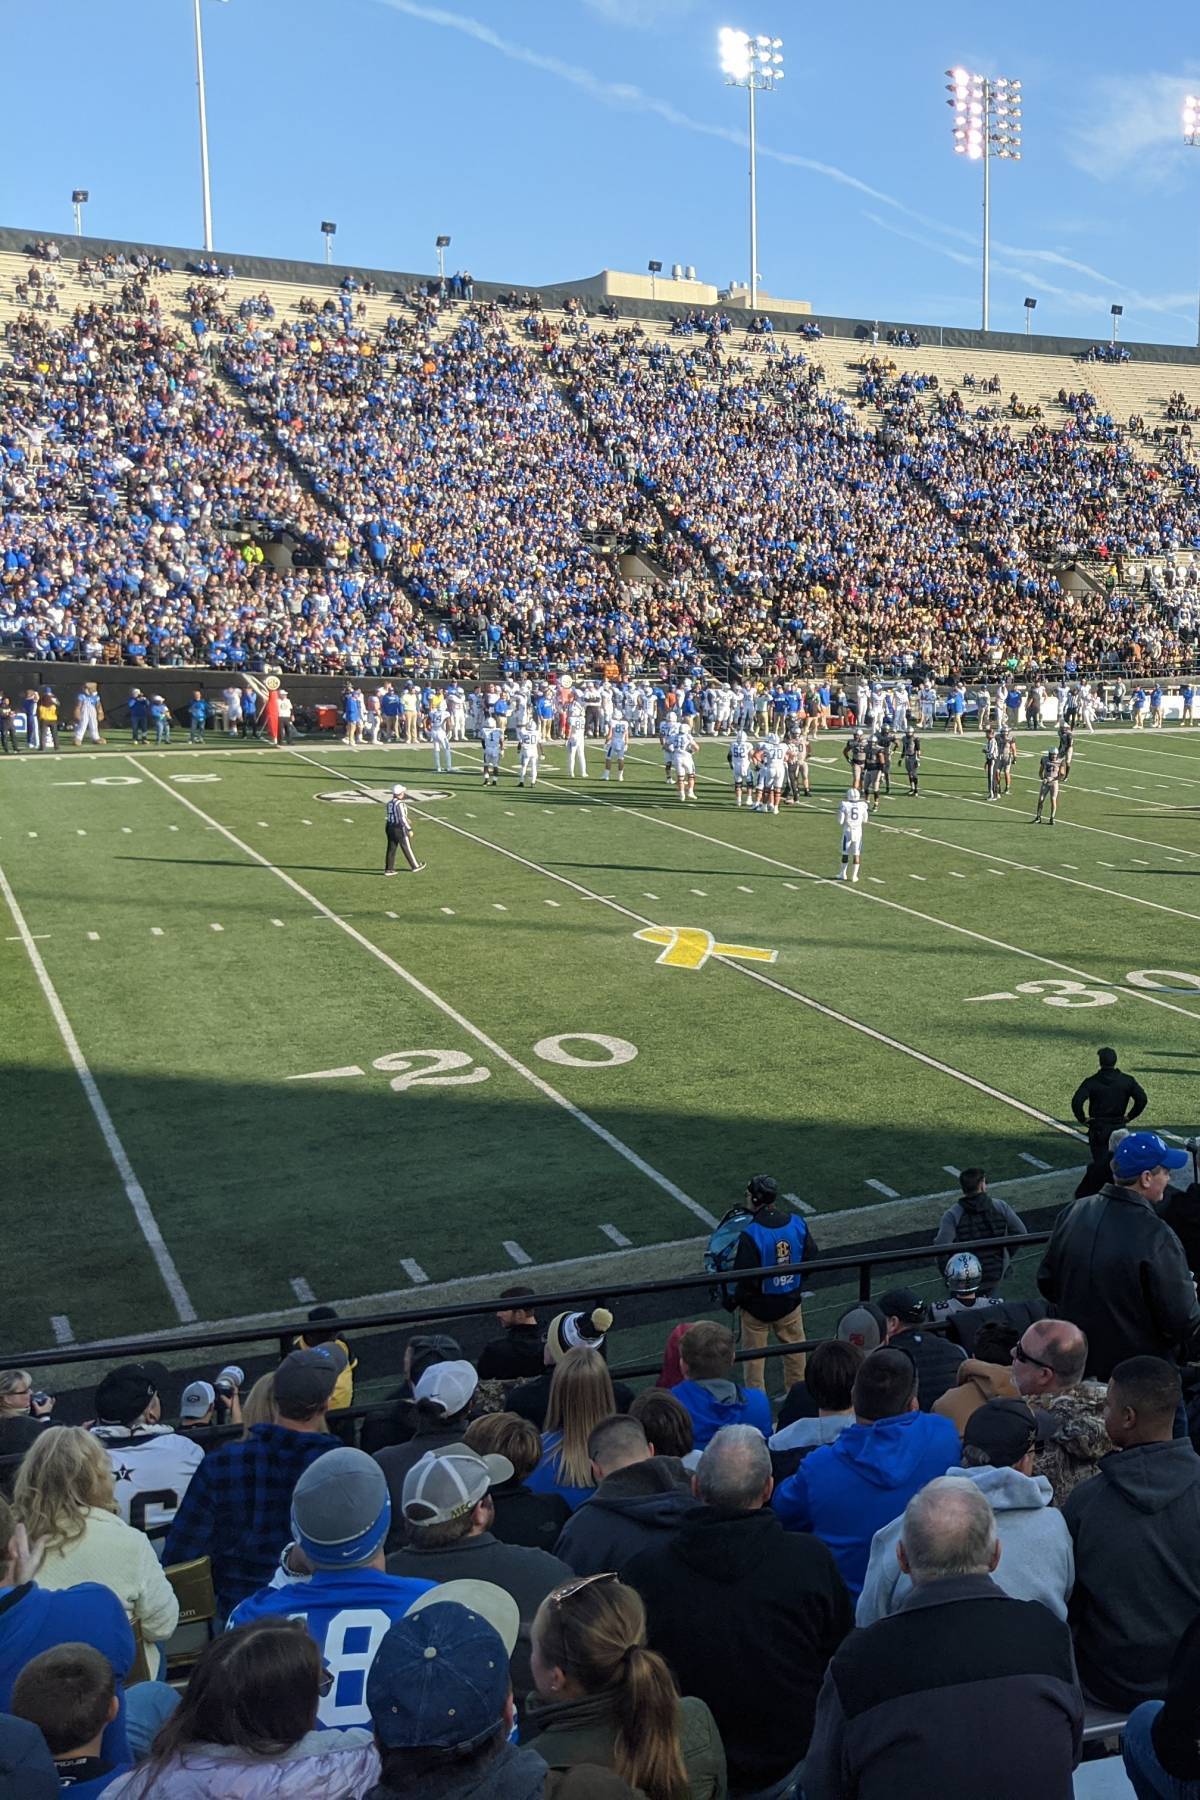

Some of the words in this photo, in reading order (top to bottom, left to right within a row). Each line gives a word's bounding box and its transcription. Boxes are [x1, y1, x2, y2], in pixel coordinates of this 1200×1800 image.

[850, 806, 859, 820] 6
[372, 1032, 639, 1092] 20
[772, 1274, 795, 1287] 092
[287, 1608, 391, 1728] 8
